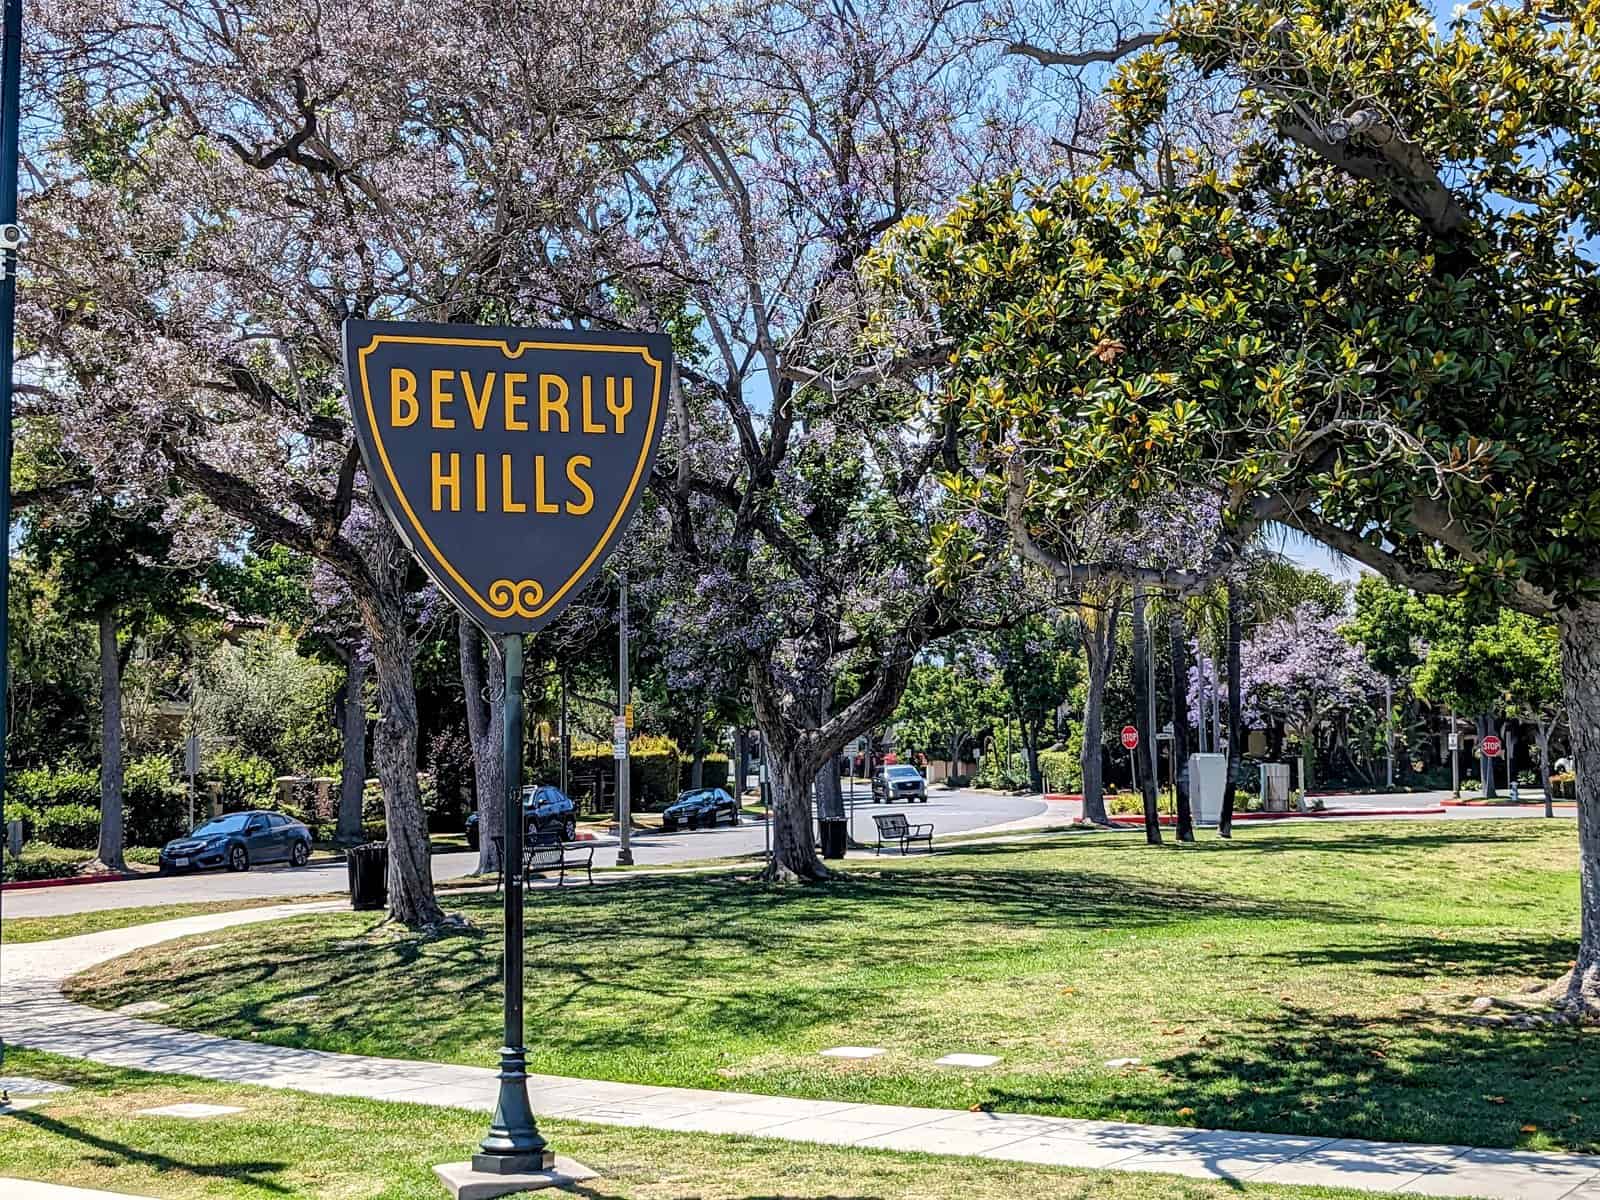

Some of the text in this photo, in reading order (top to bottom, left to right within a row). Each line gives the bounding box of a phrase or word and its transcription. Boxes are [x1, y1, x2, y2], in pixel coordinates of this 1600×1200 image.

[390, 368, 634, 434] BEVERLY
[431, 452, 595, 515] HILLS
[1122, 732, 1137, 742] STOP
[1483, 742, 1500, 750] STOP
